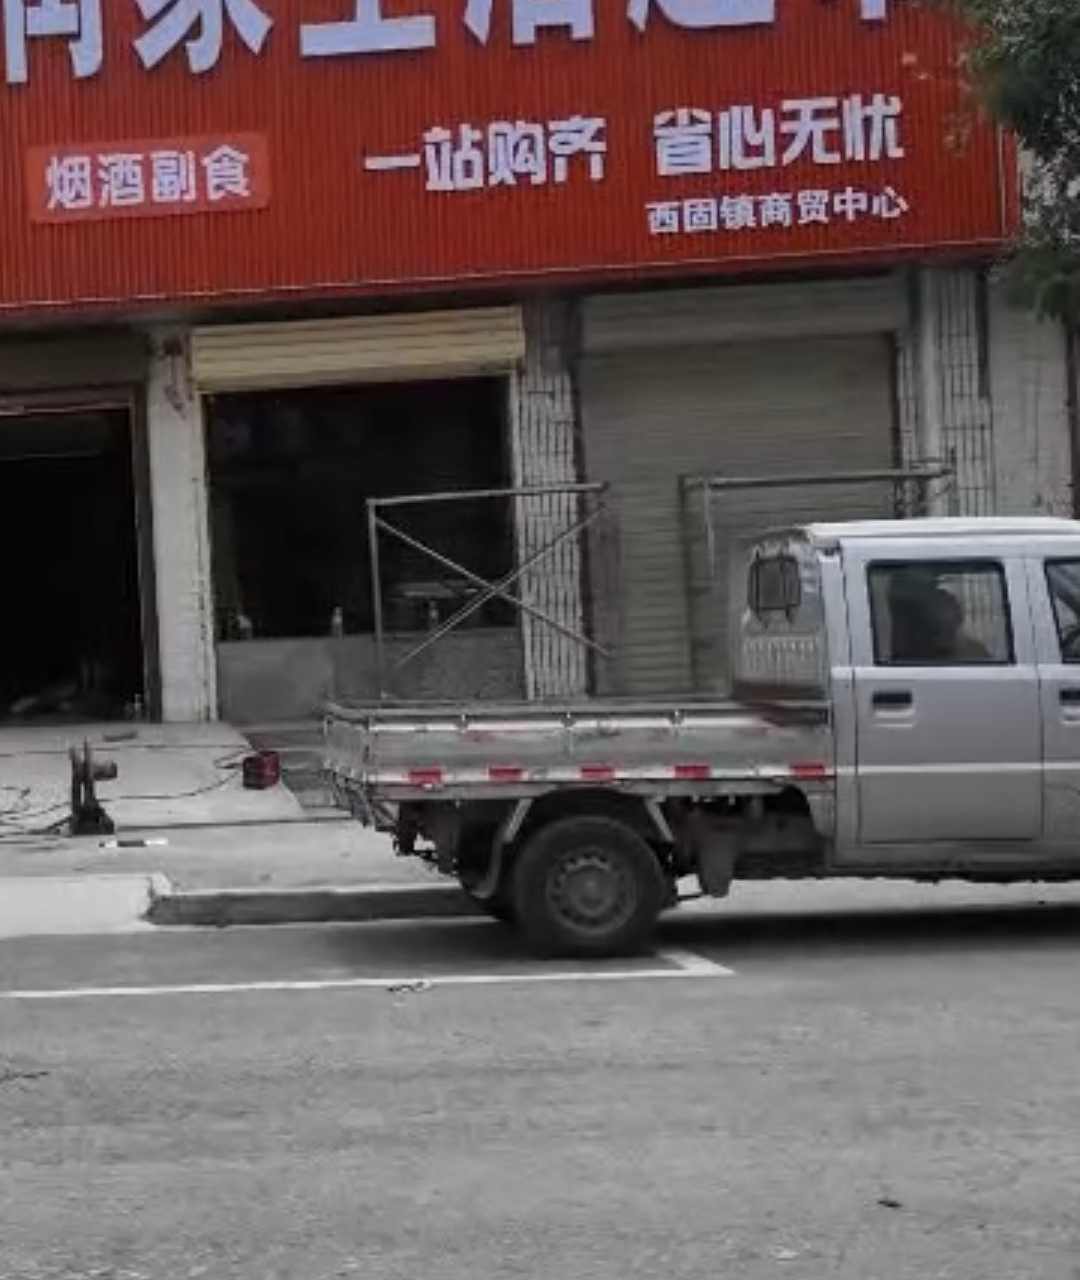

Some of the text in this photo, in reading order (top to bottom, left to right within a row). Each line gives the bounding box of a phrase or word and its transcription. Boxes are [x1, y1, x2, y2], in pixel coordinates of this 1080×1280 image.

[364, 94, 904, 193] 一站购齐 省心无忧
[46, 144, 252, 211] 烟酒副食
[645, 186, 909, 236] 西固镇商贸中心
